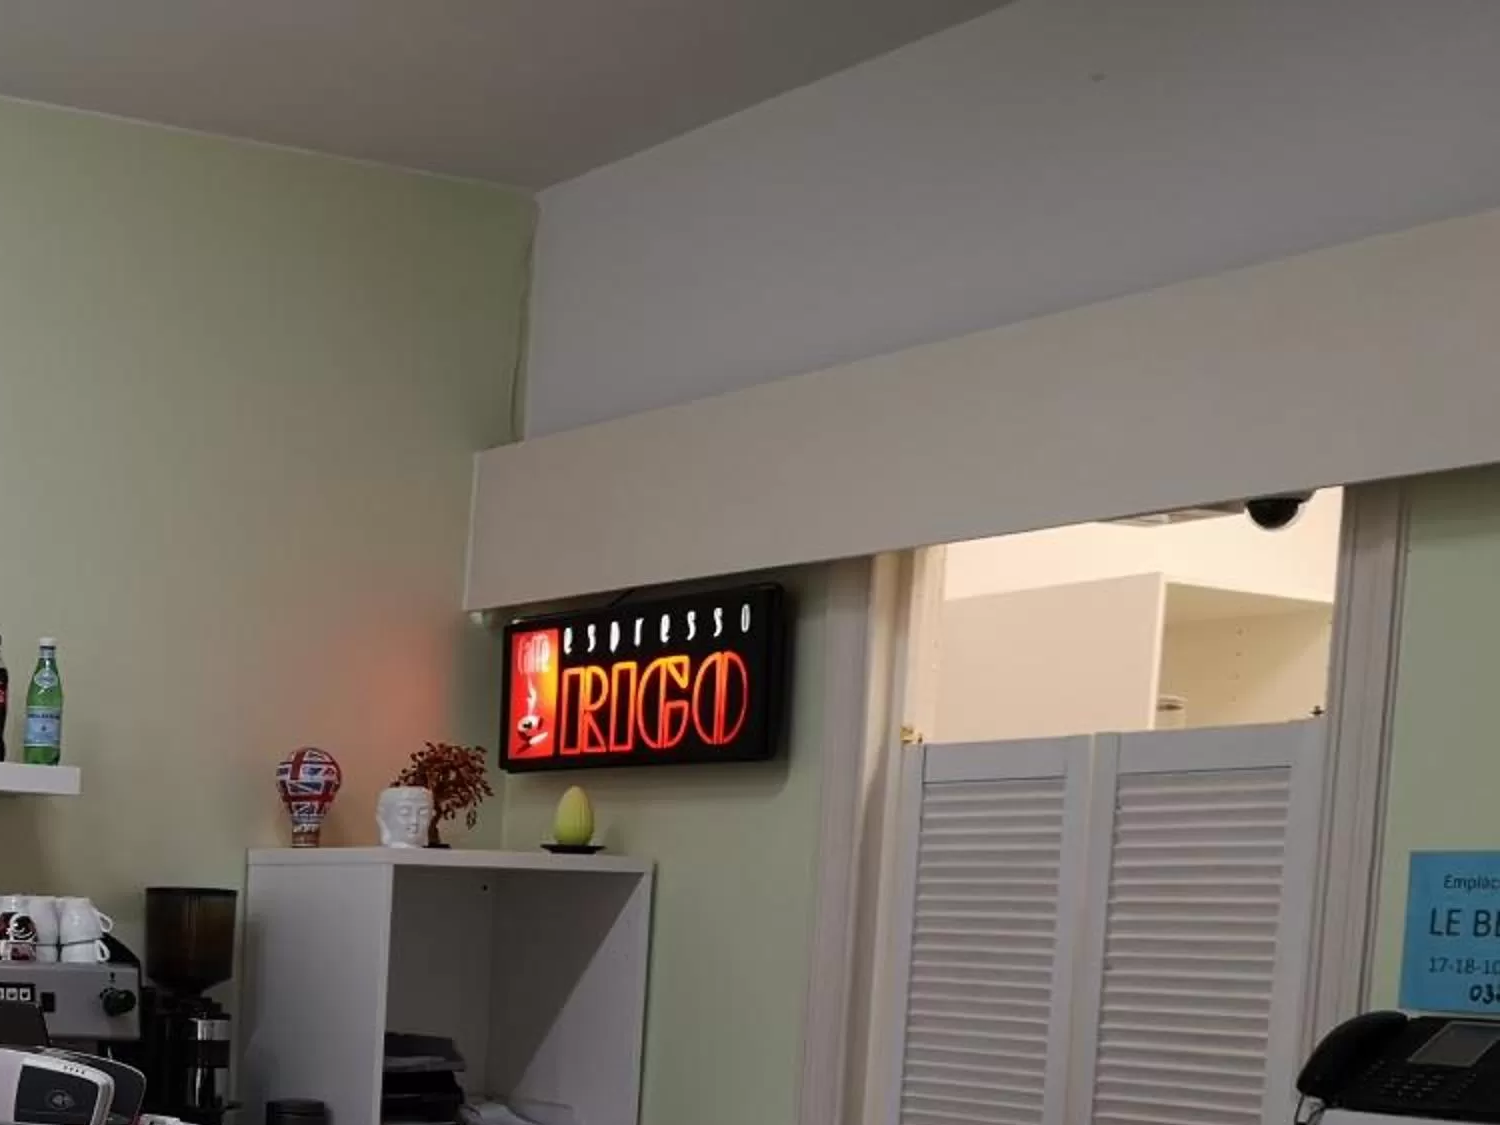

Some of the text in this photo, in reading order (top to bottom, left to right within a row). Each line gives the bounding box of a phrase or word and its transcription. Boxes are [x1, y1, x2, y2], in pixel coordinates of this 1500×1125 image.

[563, 603, 751, 654] espresso
[560, 650, 748, 755] RIGO
[1429, 907, 1462, 937] LE
